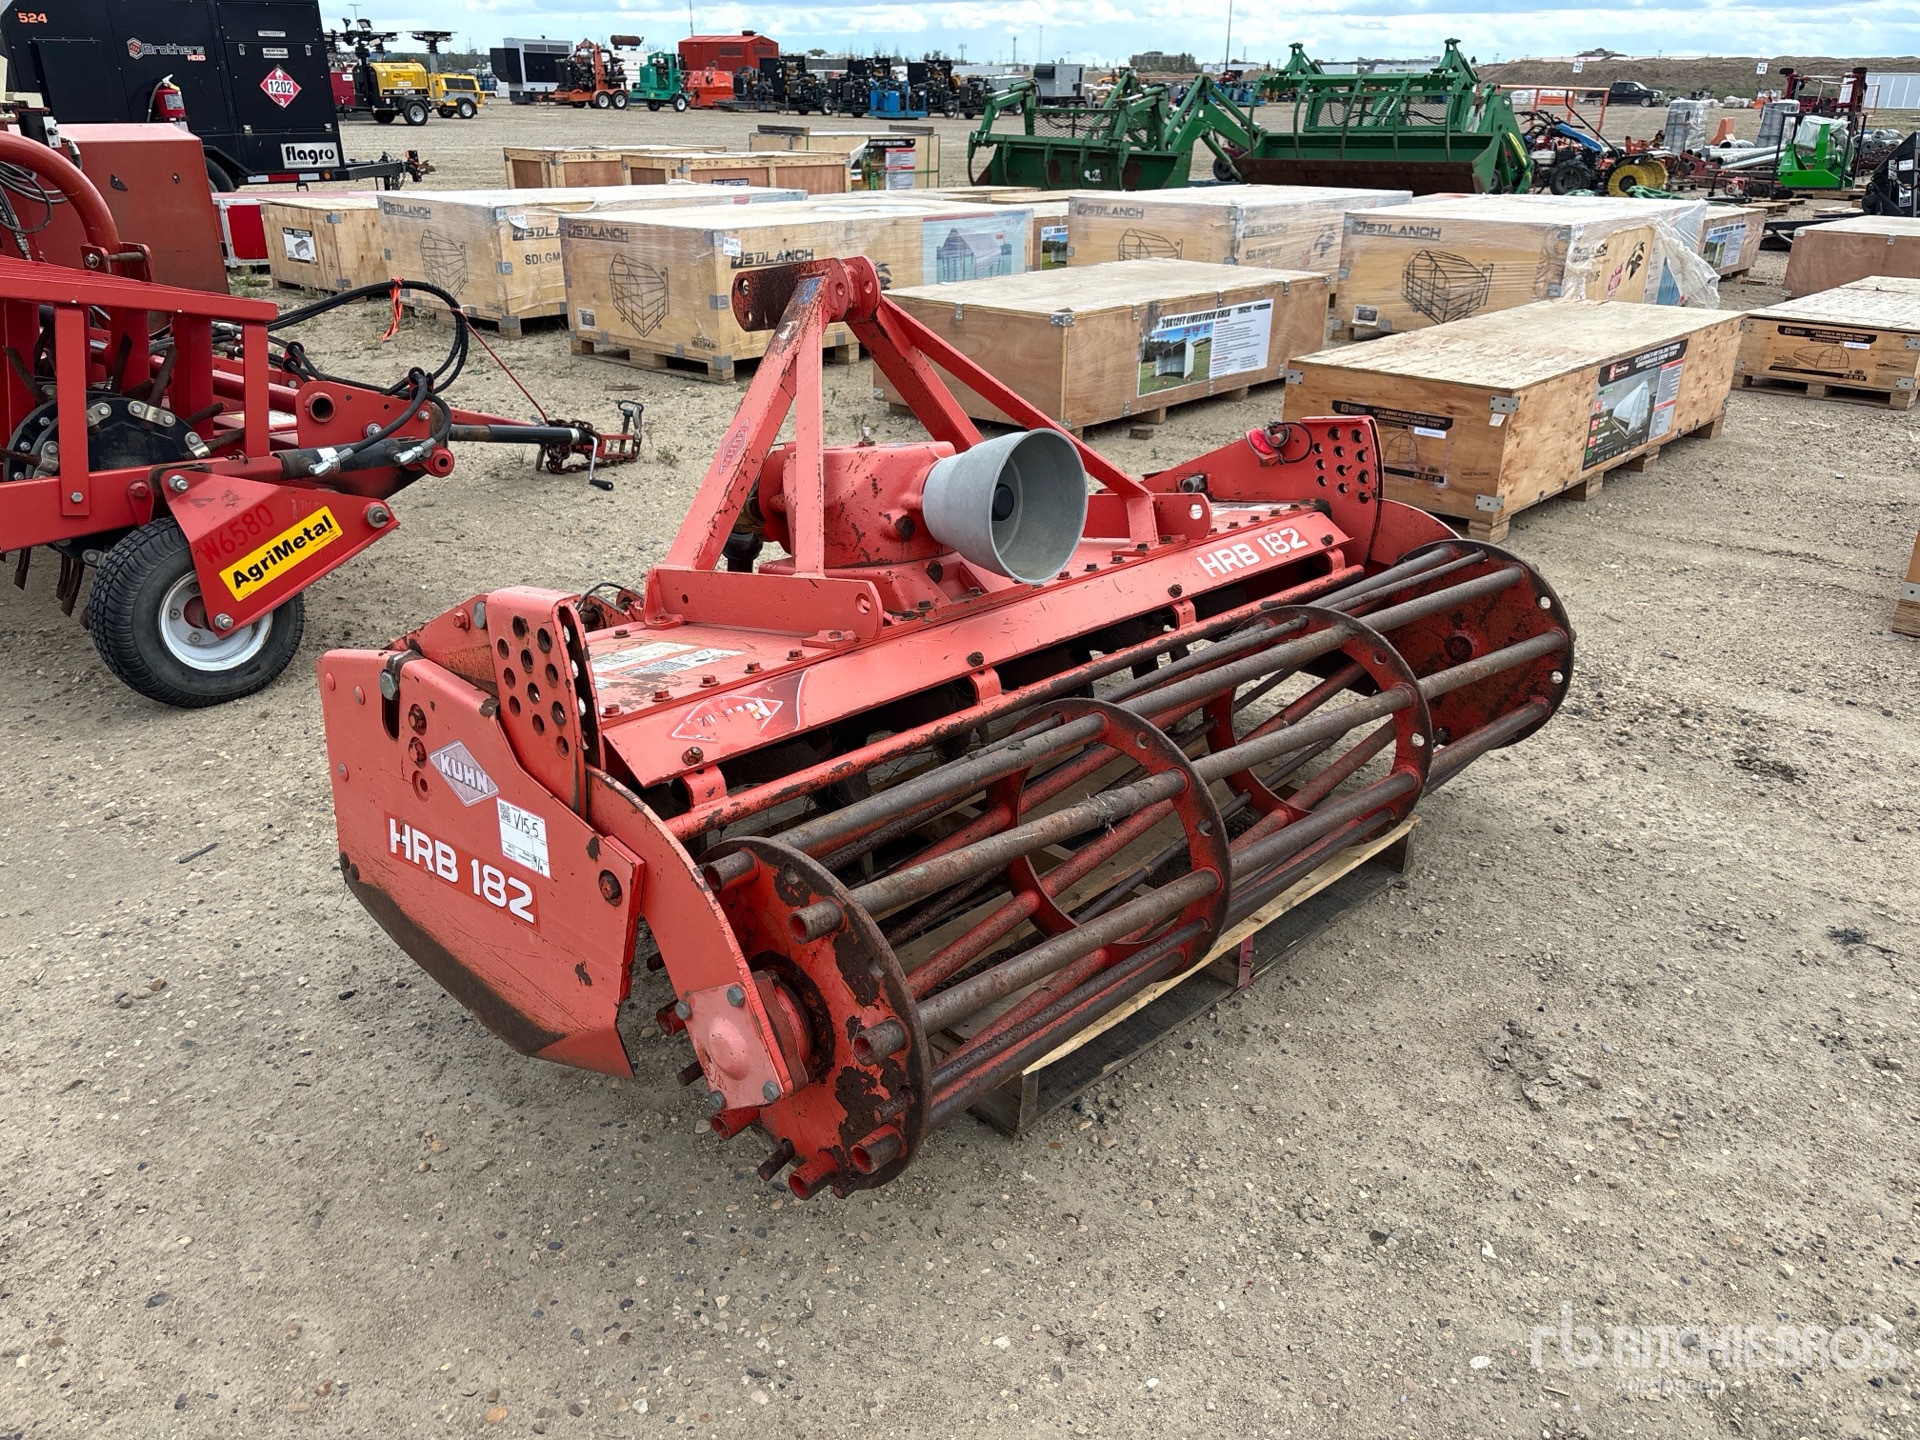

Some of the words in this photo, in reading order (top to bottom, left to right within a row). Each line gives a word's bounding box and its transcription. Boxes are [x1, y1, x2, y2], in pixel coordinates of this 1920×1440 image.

[18, 12, 48, 23] 524
[142, 43, 205, 55] Brothers
[269, 80, 292, 93] 1202
[285, 146, 335, 165] flagro
[1087, 205, 1145, 218] SDLANCH
[575, 225, 629, 241] SDLANCH
[1366, 223, 1442, 238] SDLANCH
[744, 248, 814, 265] SDLANCH
[1187, 310, 1217, 324] LIVESTOCK
[1217, 308, 1232, 319] SHED
[201, 503, 275, 565] W6580
[232, 514, 333, 590] AgriMetal
[1196, 543, 1261, 578] HRB
[1256, 527, 1309, 558] 182
[439, 752, 489, 794] KUHN
[389, 817, 459, 884] HRB
[470, 858, 535, 924] 182
